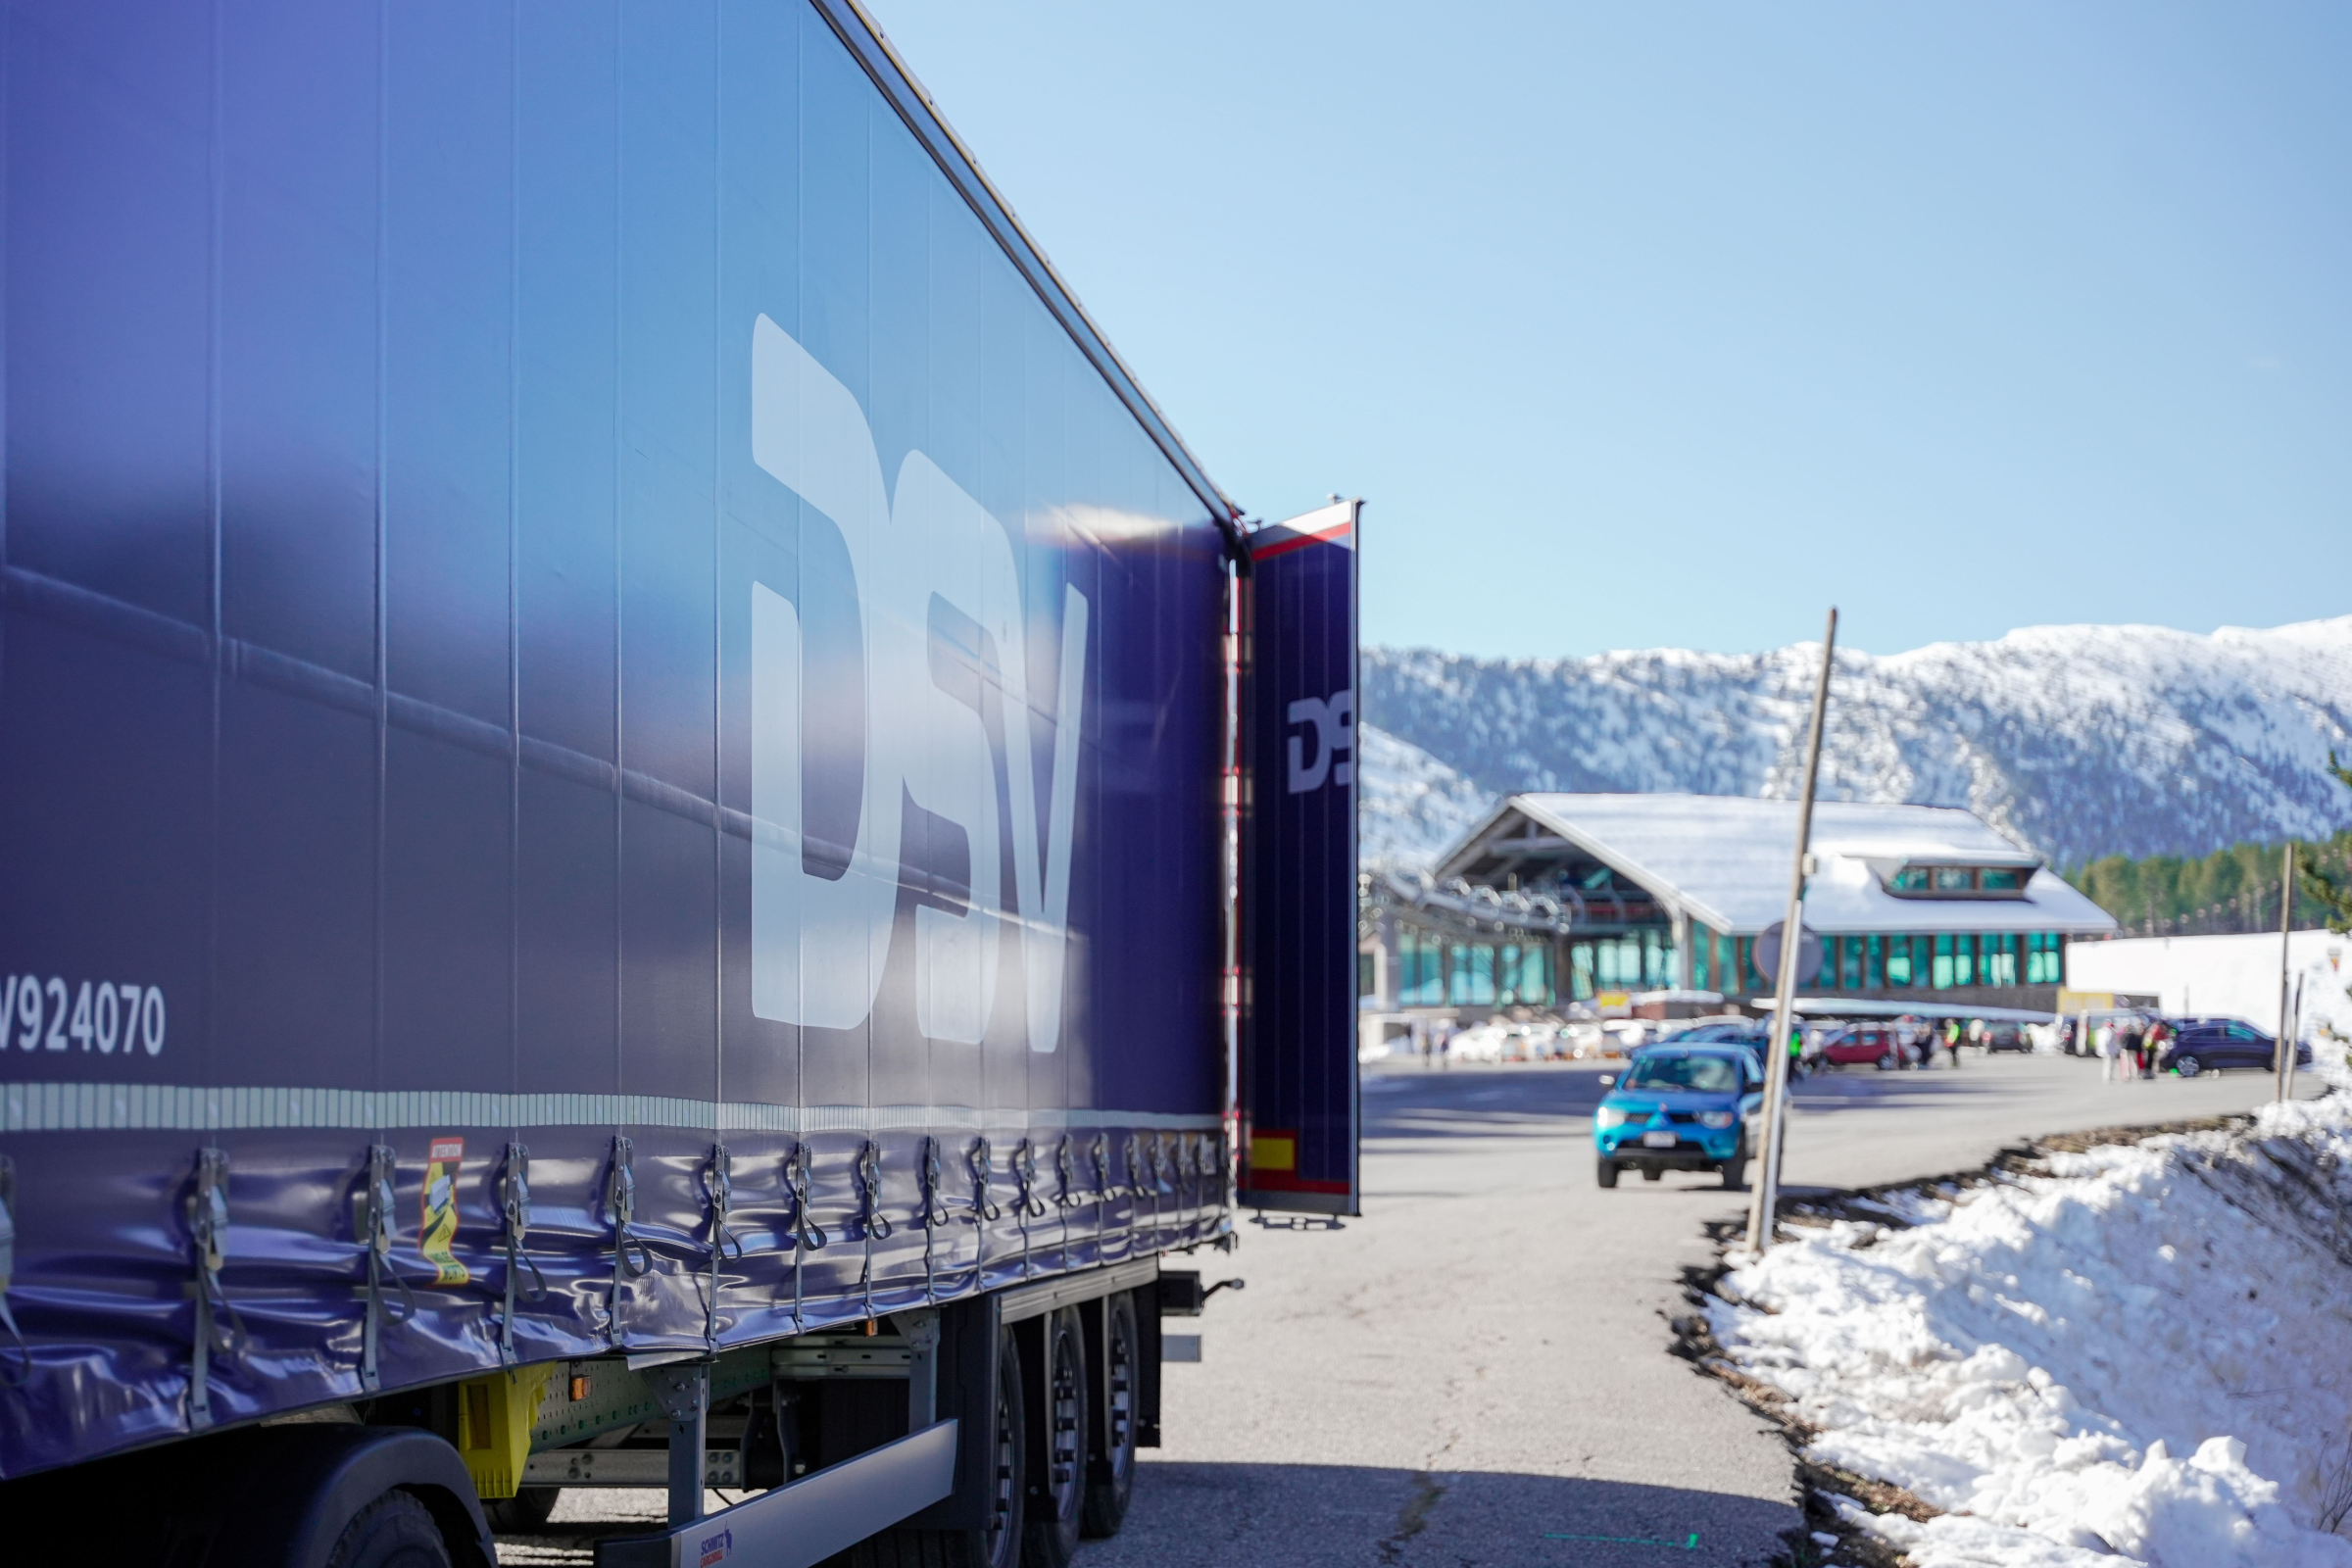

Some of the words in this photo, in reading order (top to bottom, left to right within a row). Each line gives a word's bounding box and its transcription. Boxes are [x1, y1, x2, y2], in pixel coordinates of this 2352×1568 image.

[752, 312, 1089, 1053] DSV
[431, 1143, 463, 1158] ATTENTION
[701, 1532, 724, 1556] SCHMITZ
